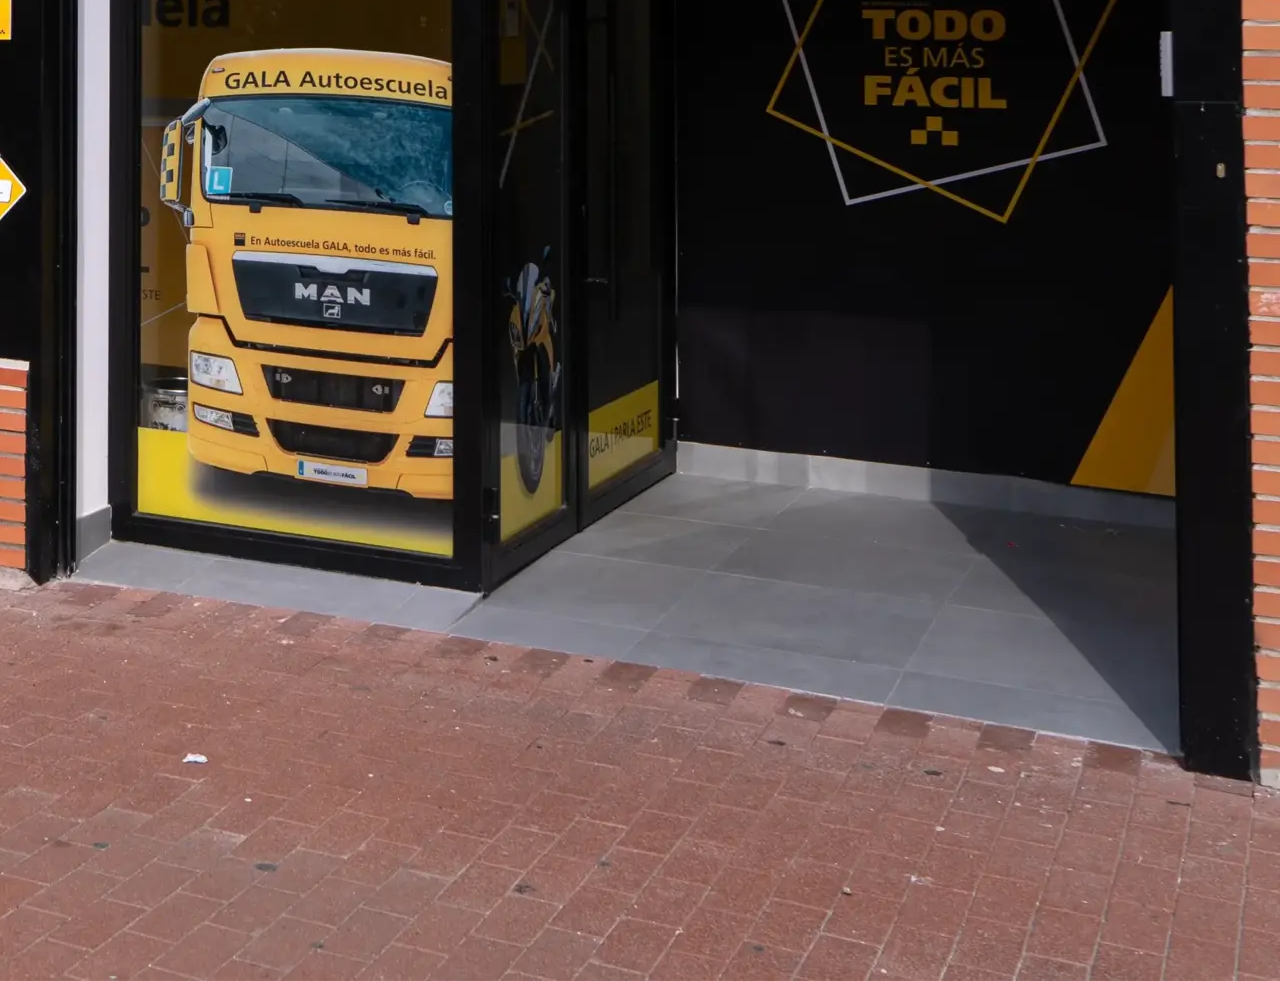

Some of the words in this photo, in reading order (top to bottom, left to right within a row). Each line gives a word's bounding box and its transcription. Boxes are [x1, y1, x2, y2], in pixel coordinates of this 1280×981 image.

[862, 9, 1006, 41] TODO
[885, 47, 912, 67] ES
[923, 42, 985, 69] MÁS
[225, 70, 291, 89] GALA
[299, 71, 448, 100] Autoescuela
[864, 68, 1007, 109] FÁCIL
[251, 236, 262, 246] En
[264, 237, 320, 249] Autoescuela
[322, 241, 352, 253] GALA,
[354, 244, 377, 254] todo
[379, 247, 390, 256] es
[392, 247, 411, 258] más
[414, 248, 436, 260] fácil.
[294, 282, 371, 305] MAN
[590, 431, 609, 458] GALA
